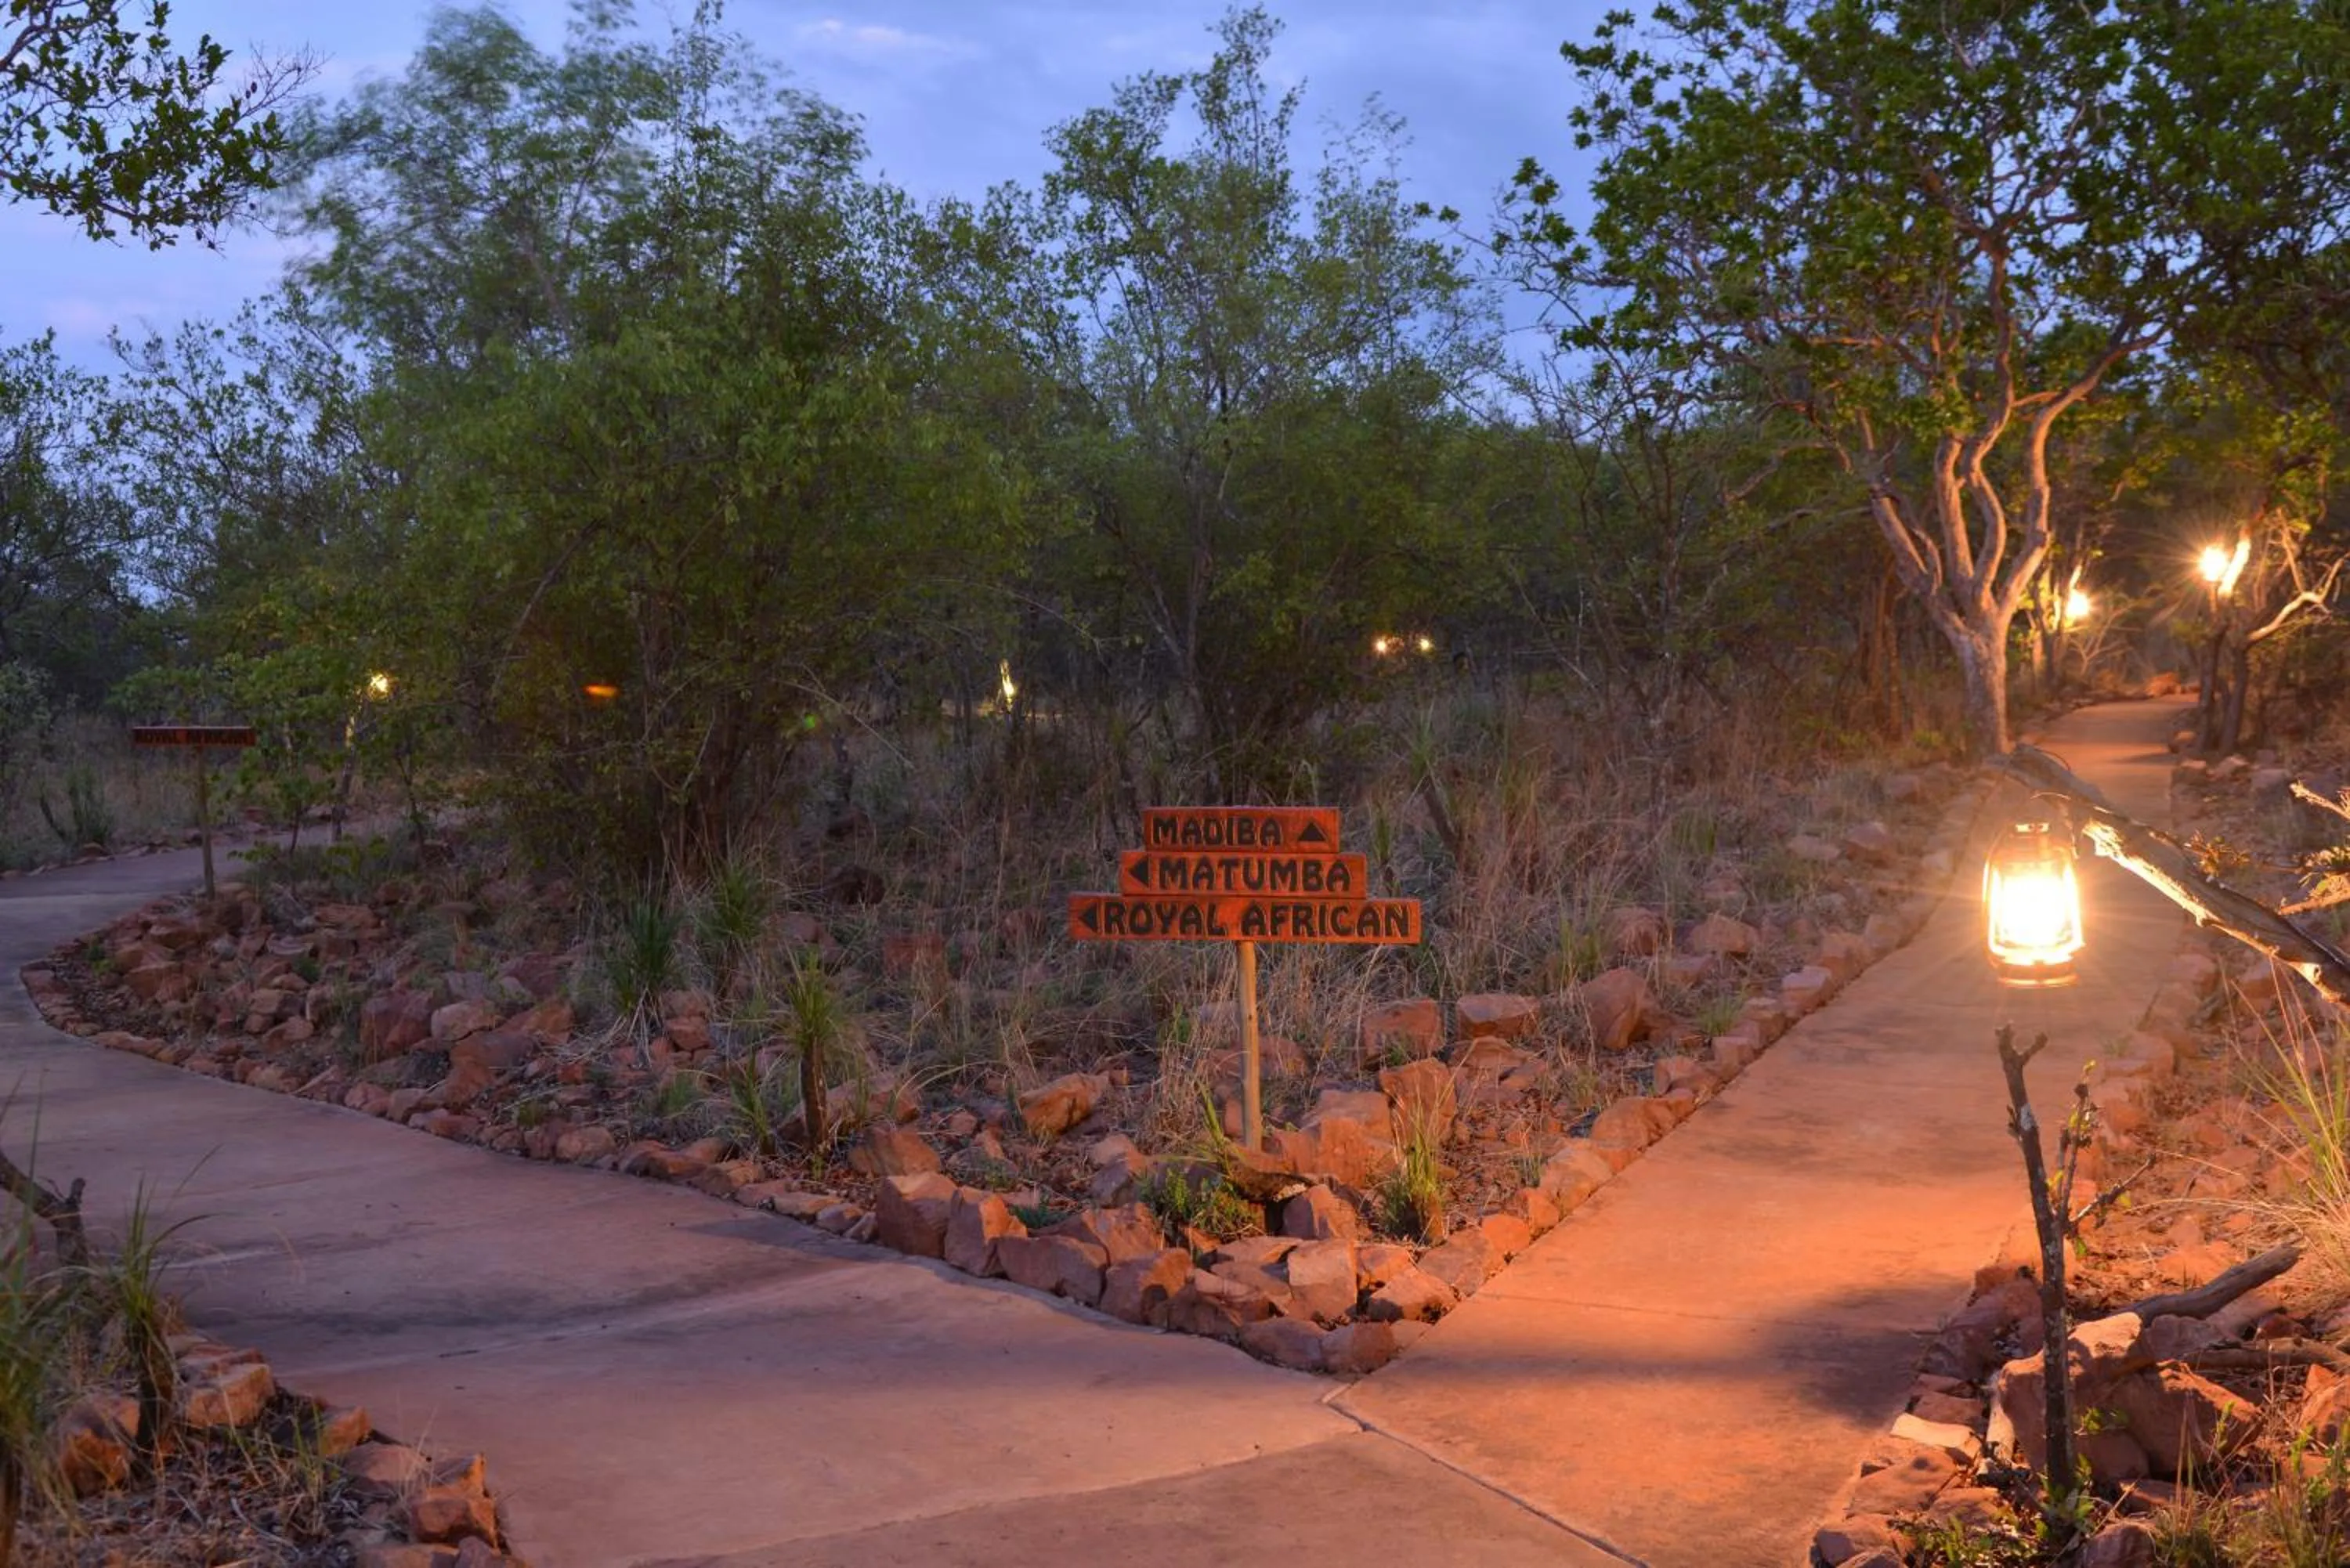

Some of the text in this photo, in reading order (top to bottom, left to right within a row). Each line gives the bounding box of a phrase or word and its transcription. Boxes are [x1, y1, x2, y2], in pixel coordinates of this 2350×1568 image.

[1152, 816, 1282, 846] MADIBA
[1159, 857, 1351, 892] MATUMBA
[1104, 901, 1409, 937] ROYAL AFRICAN
